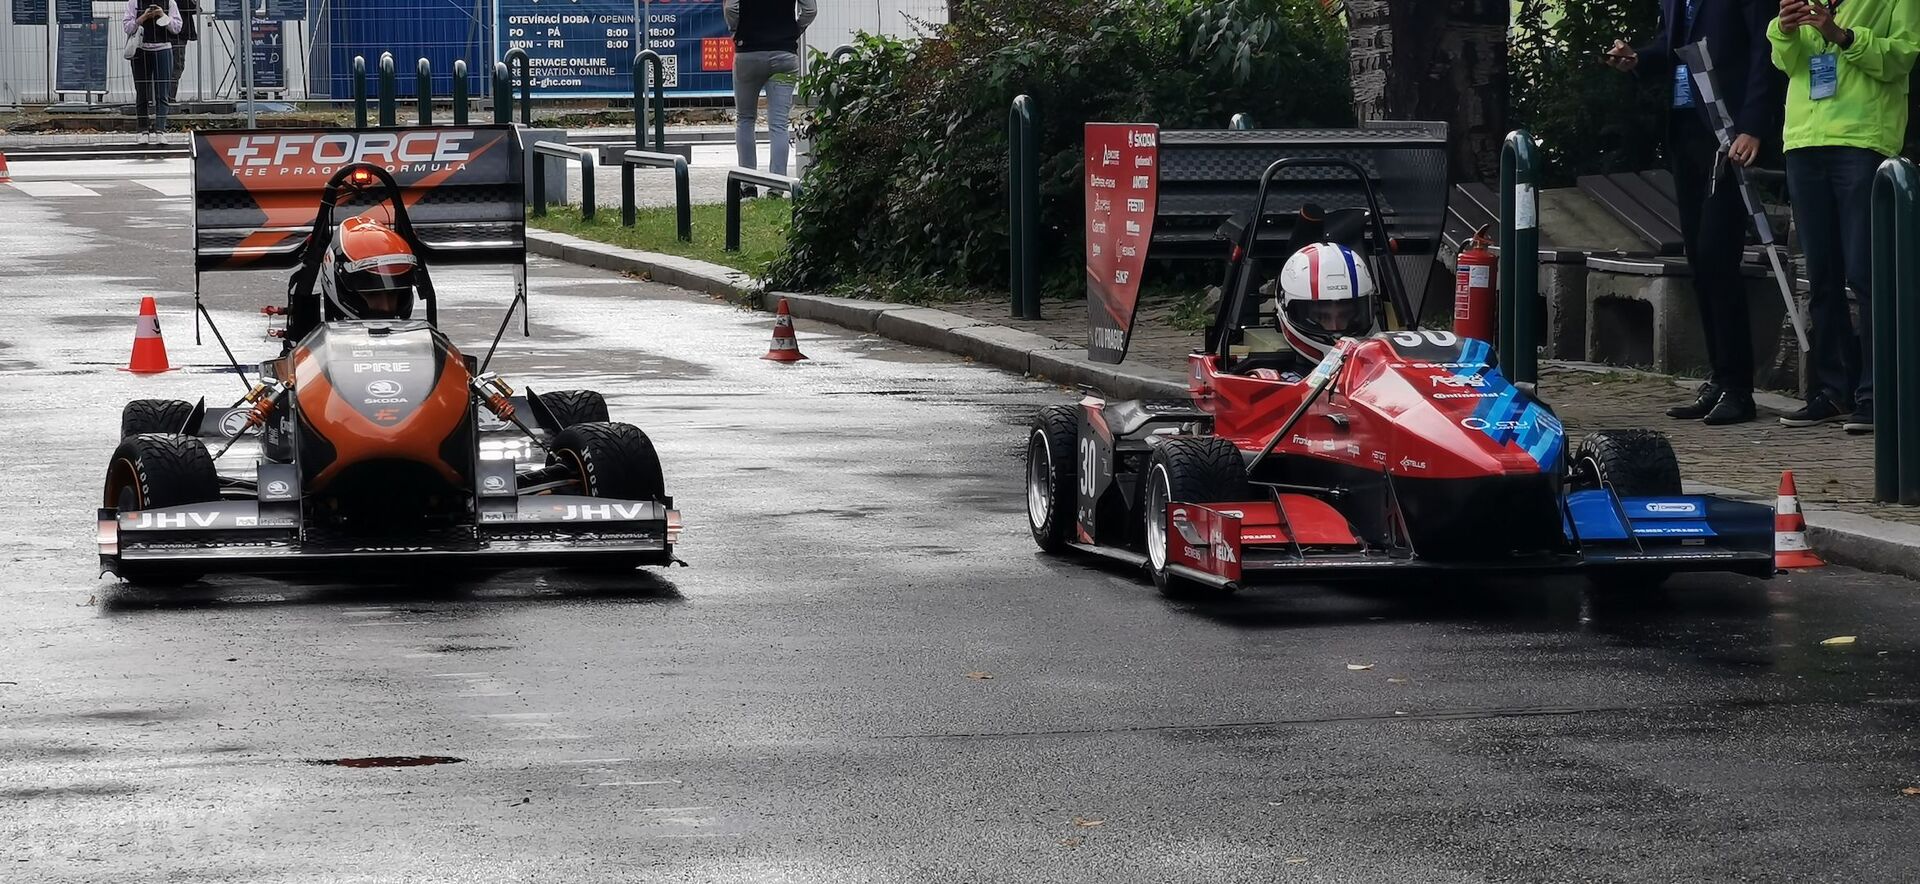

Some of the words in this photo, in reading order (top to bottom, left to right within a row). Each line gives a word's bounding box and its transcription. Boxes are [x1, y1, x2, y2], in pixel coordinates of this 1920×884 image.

[509, 13, 561, 24] OTEVÍRACÍ
[562, 15, 590, 24] DOBA
[648, 14, 677, 24] OURS
[509, 28, 524, 37] PO
[548, 26, 561, 37] PÁ
[606, 28, 628, 37] 8:00
[649, 28, 676, 37] 18:00
[509, 40, 534, 49] MON
[548, 40, 564, 49] FRI
[606, 40, 629, 49] 8:00
[649, 40, 676, 48] 18:00
[512, 58, 567, 67] REERVACE
[569, 58, 607, 66] ONLINE
[512, 67, 576, 77] REERVATION
[579, 67, 615, 76] ONLINE
[232, 168, 267, 177] FEE
[280, 165, 341, 176] PRAG
[385, 162, 467, 173] ORMULA
[353, 362, 411, 373] PRE
[1080, 437, 1096, 497] 30
[562, 503, 645, 520] JHV
[135, 511, 221, 528] JHV
